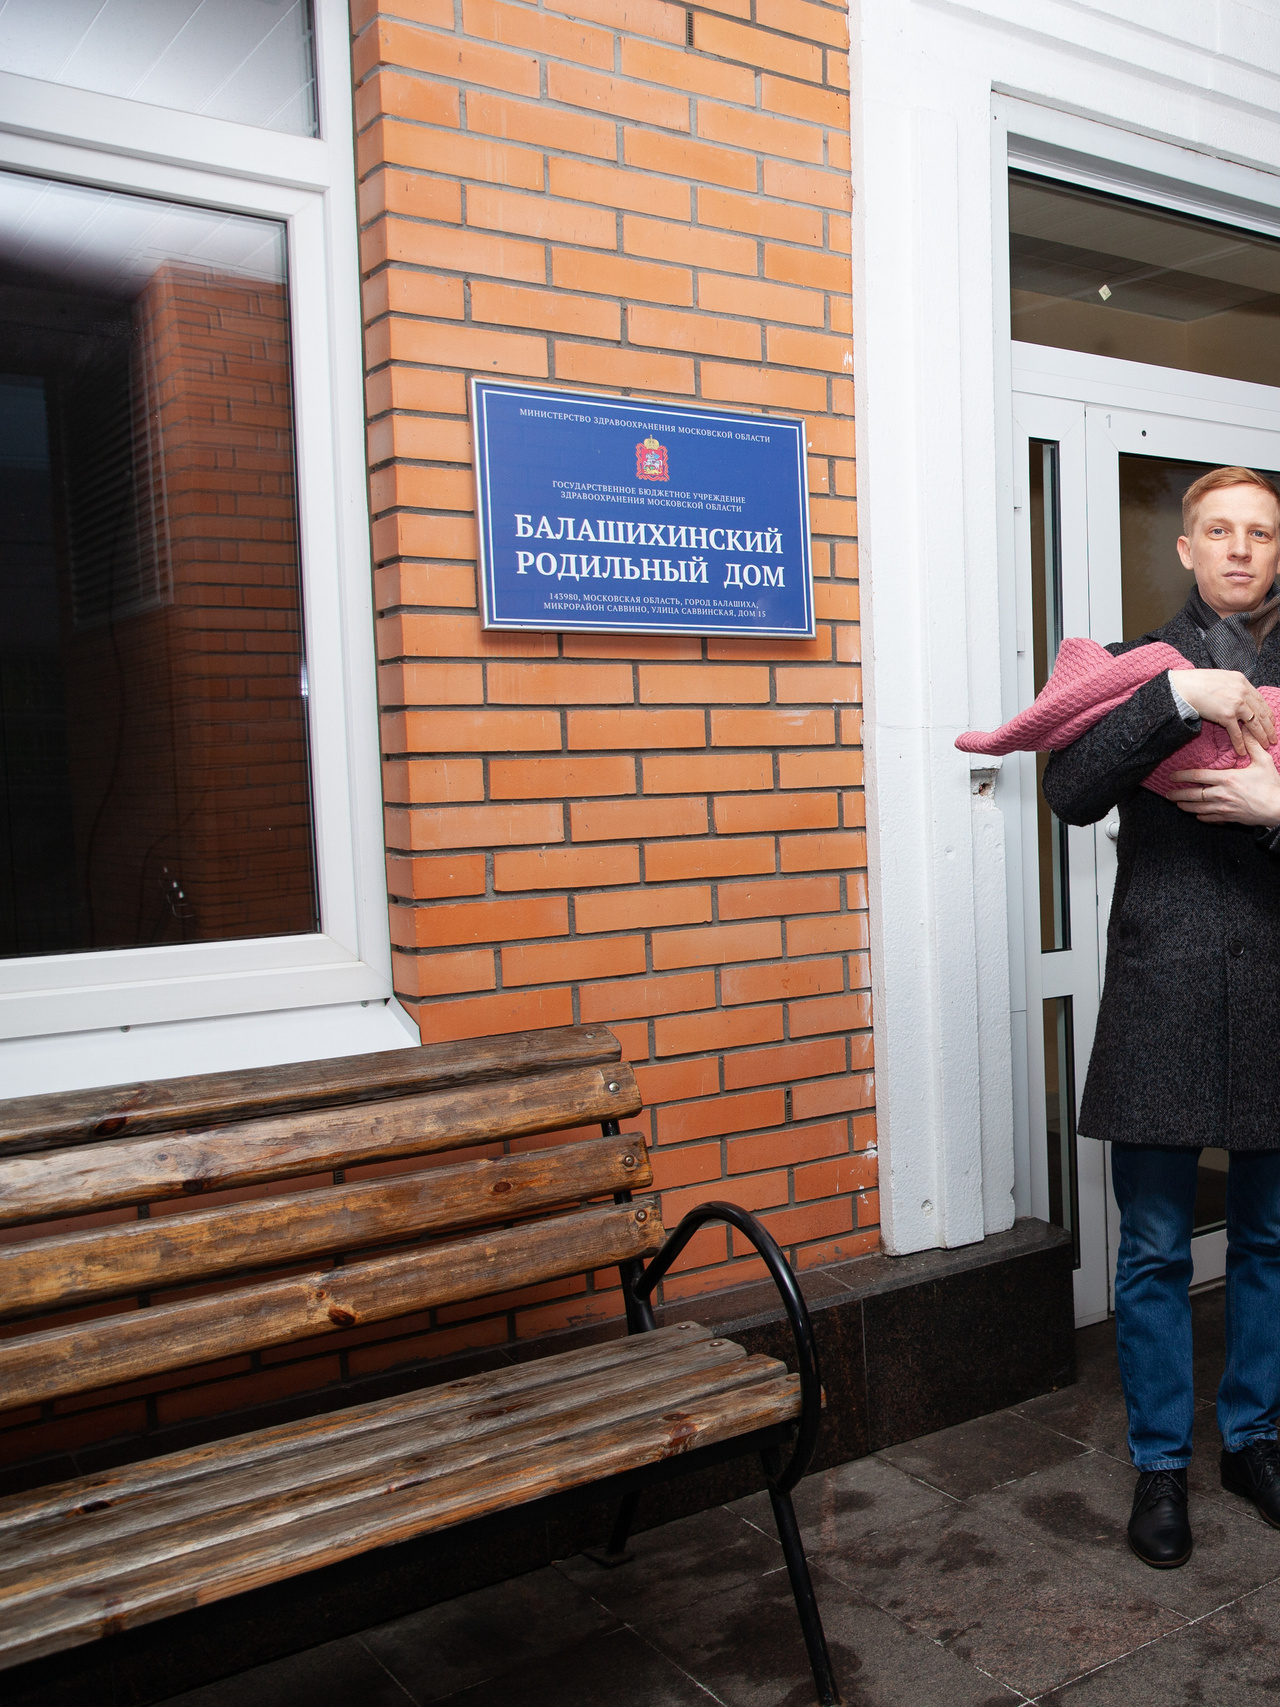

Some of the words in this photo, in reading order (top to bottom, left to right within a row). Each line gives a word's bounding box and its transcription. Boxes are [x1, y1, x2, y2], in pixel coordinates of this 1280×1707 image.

[519, 408, 592, 423] МИНИСТЕРСТВО
[593, 416, 676, 432] ЗДРАВООХРАНЕНИЯ
[678, 426, 733, 439] МОСКОВСКОЙ
[735, 432, 771, 443] ОБЛАСТИ
[552, 480, 636, 495] ГОСУДАРСТВЕННОЕ
[638, 487, 691, 499] БЮДЖЕТНОЕ
[693, 492, 746, 504] УЧРЕЖДЕНИЕ
[560, 491, 645, 505] ЗДРАВООХРАНЕНИЯ
[647, 498, 704, 510] МОСКОВСКОЙ
[705, 503, 742, 513] ОБЛАСТИ
[514, 513, 784, 554] БАЛАШИХИНСКИЙ
[515, 550, 709, 584] РОДИЛЬНЫЙ
[723, 563, 785, 589] ДОМ
[543, 602, 605, 612] МИКРОРАЙОН
[607, 604, 650, 614] САВВИНО,
[651, 607, 680, 616] УЛИЦА
[681, 607, 737, 617] САВВИНСКАЯ,
[737, 610, 756, 618] ДОМ
[757, 610, 767, 618] 15
[549, 592, 581, 602] 143980,
[583, 594, 641, 604] МОСКОВСКАЯ
[643, 596, 683, 606] ОБЛАСТЬ,
[684, 598, 711, 607] ГОРОД
[713, 599, 759, 609] БАЛАШИХА,
